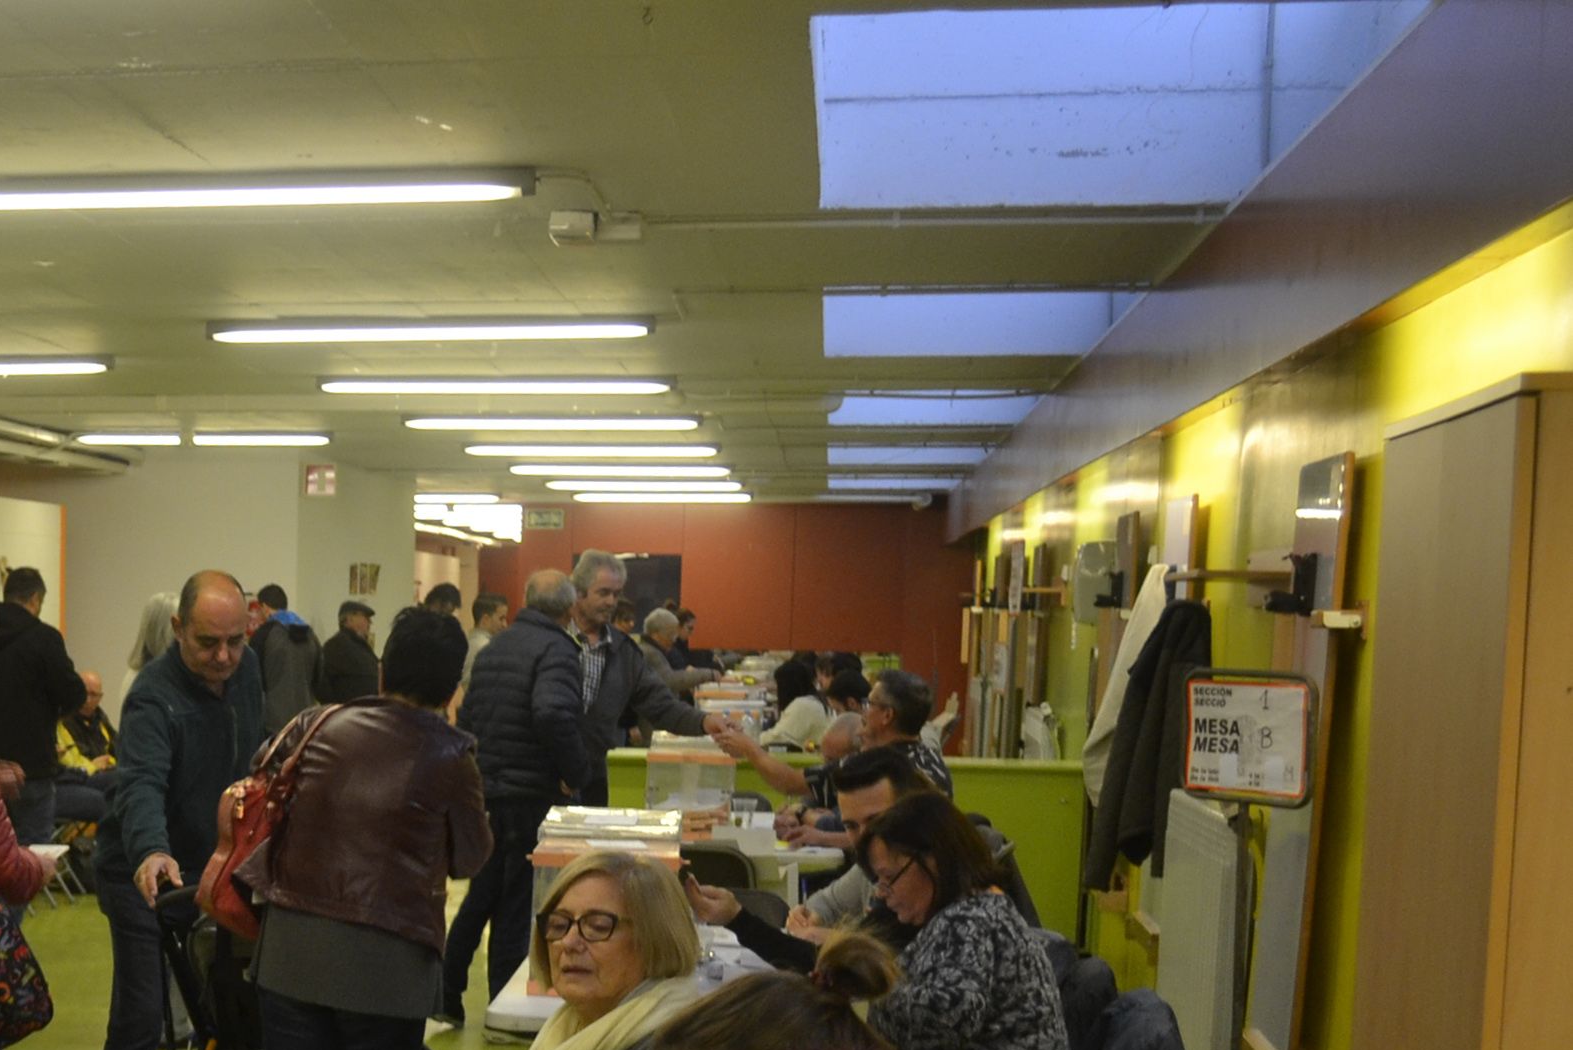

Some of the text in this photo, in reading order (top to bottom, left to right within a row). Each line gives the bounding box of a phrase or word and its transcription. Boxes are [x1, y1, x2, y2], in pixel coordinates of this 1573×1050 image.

[1260, 690, 1270, 710] 1
[1194, 718, 1240, 736] MESA
[1194, 736, 1240, 754] MESA
